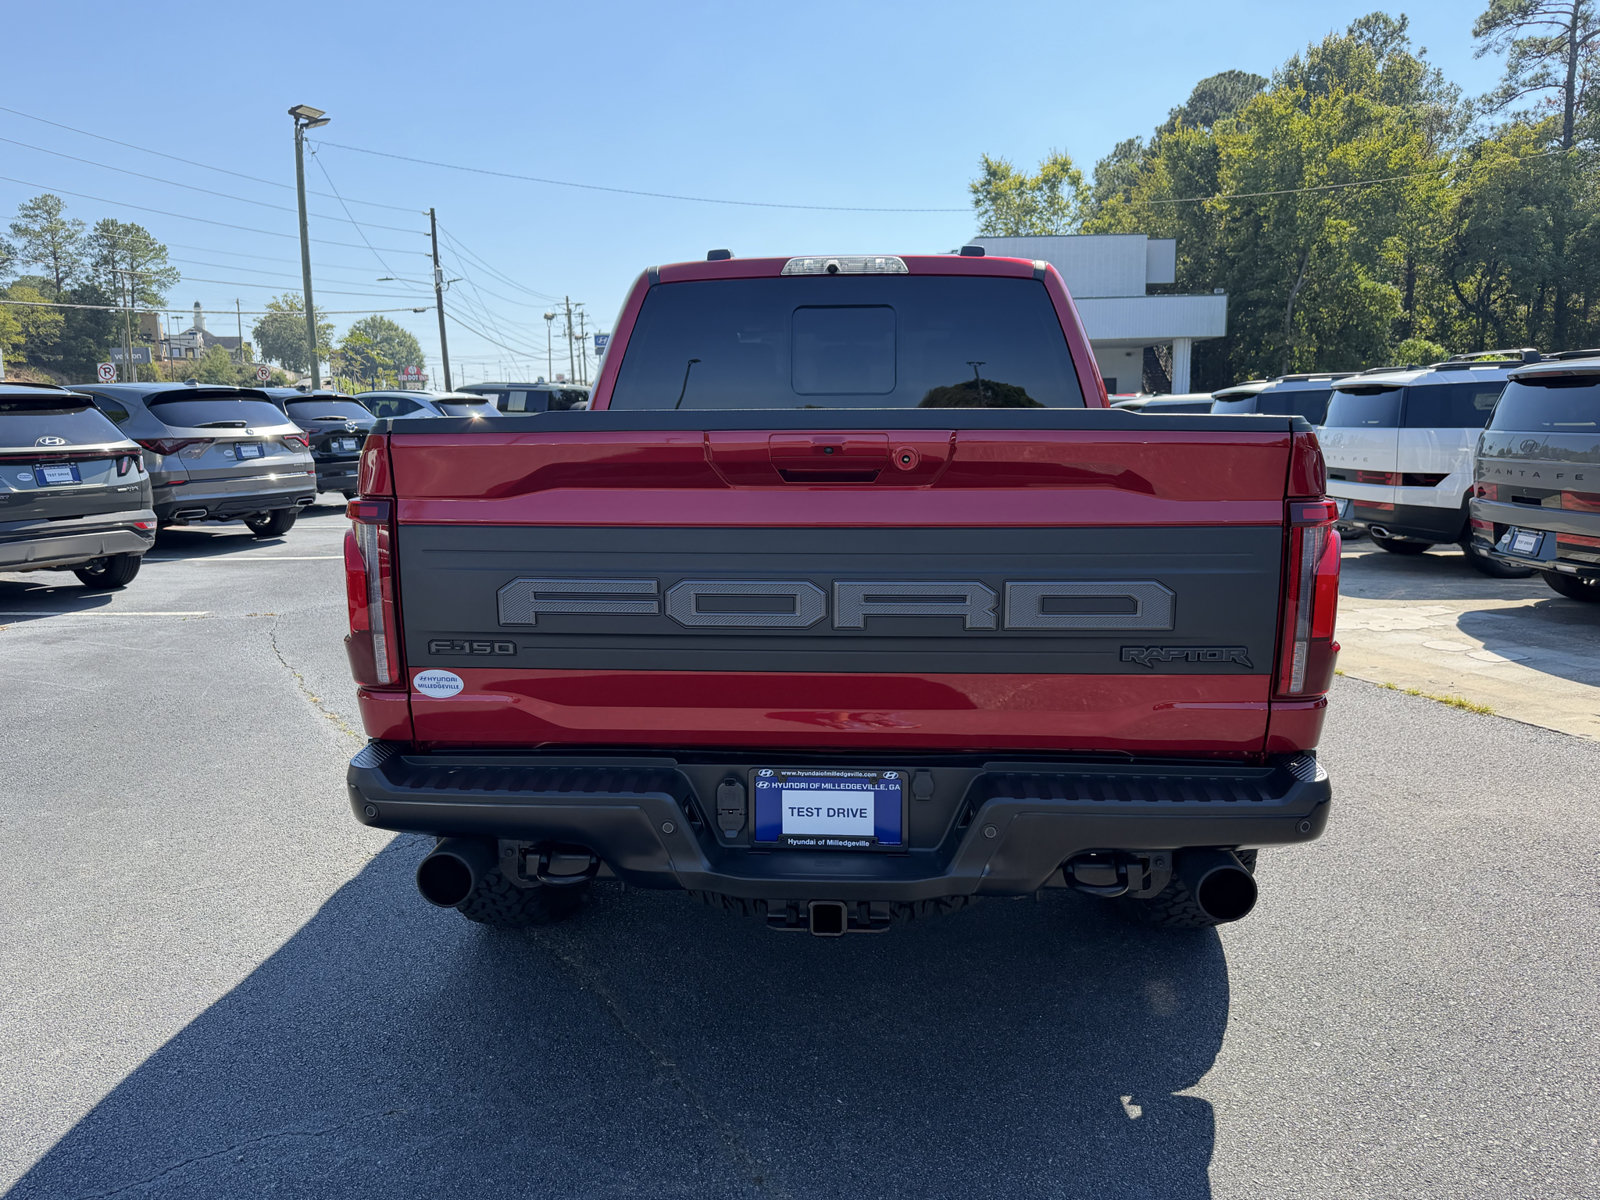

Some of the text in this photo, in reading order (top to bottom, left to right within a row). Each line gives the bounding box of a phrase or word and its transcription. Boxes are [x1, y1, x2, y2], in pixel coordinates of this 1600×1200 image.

[1485, 467, 1584, 481] SANTA FE
[497, 577, 1177, 632] FORD
[428, 639, 517, 656] F-150
[1120, 645, 1254, 669] RAPTOR
[781, 770, 877, 778] www.hyundaiofmilledgeville.com
[788, 806, 868, 818] TEST DRIVE
[787, 838, 816, 847] Hyundai
[817, 838, 826, 846] of
[826, 839, 870, 848] Milledgeville
